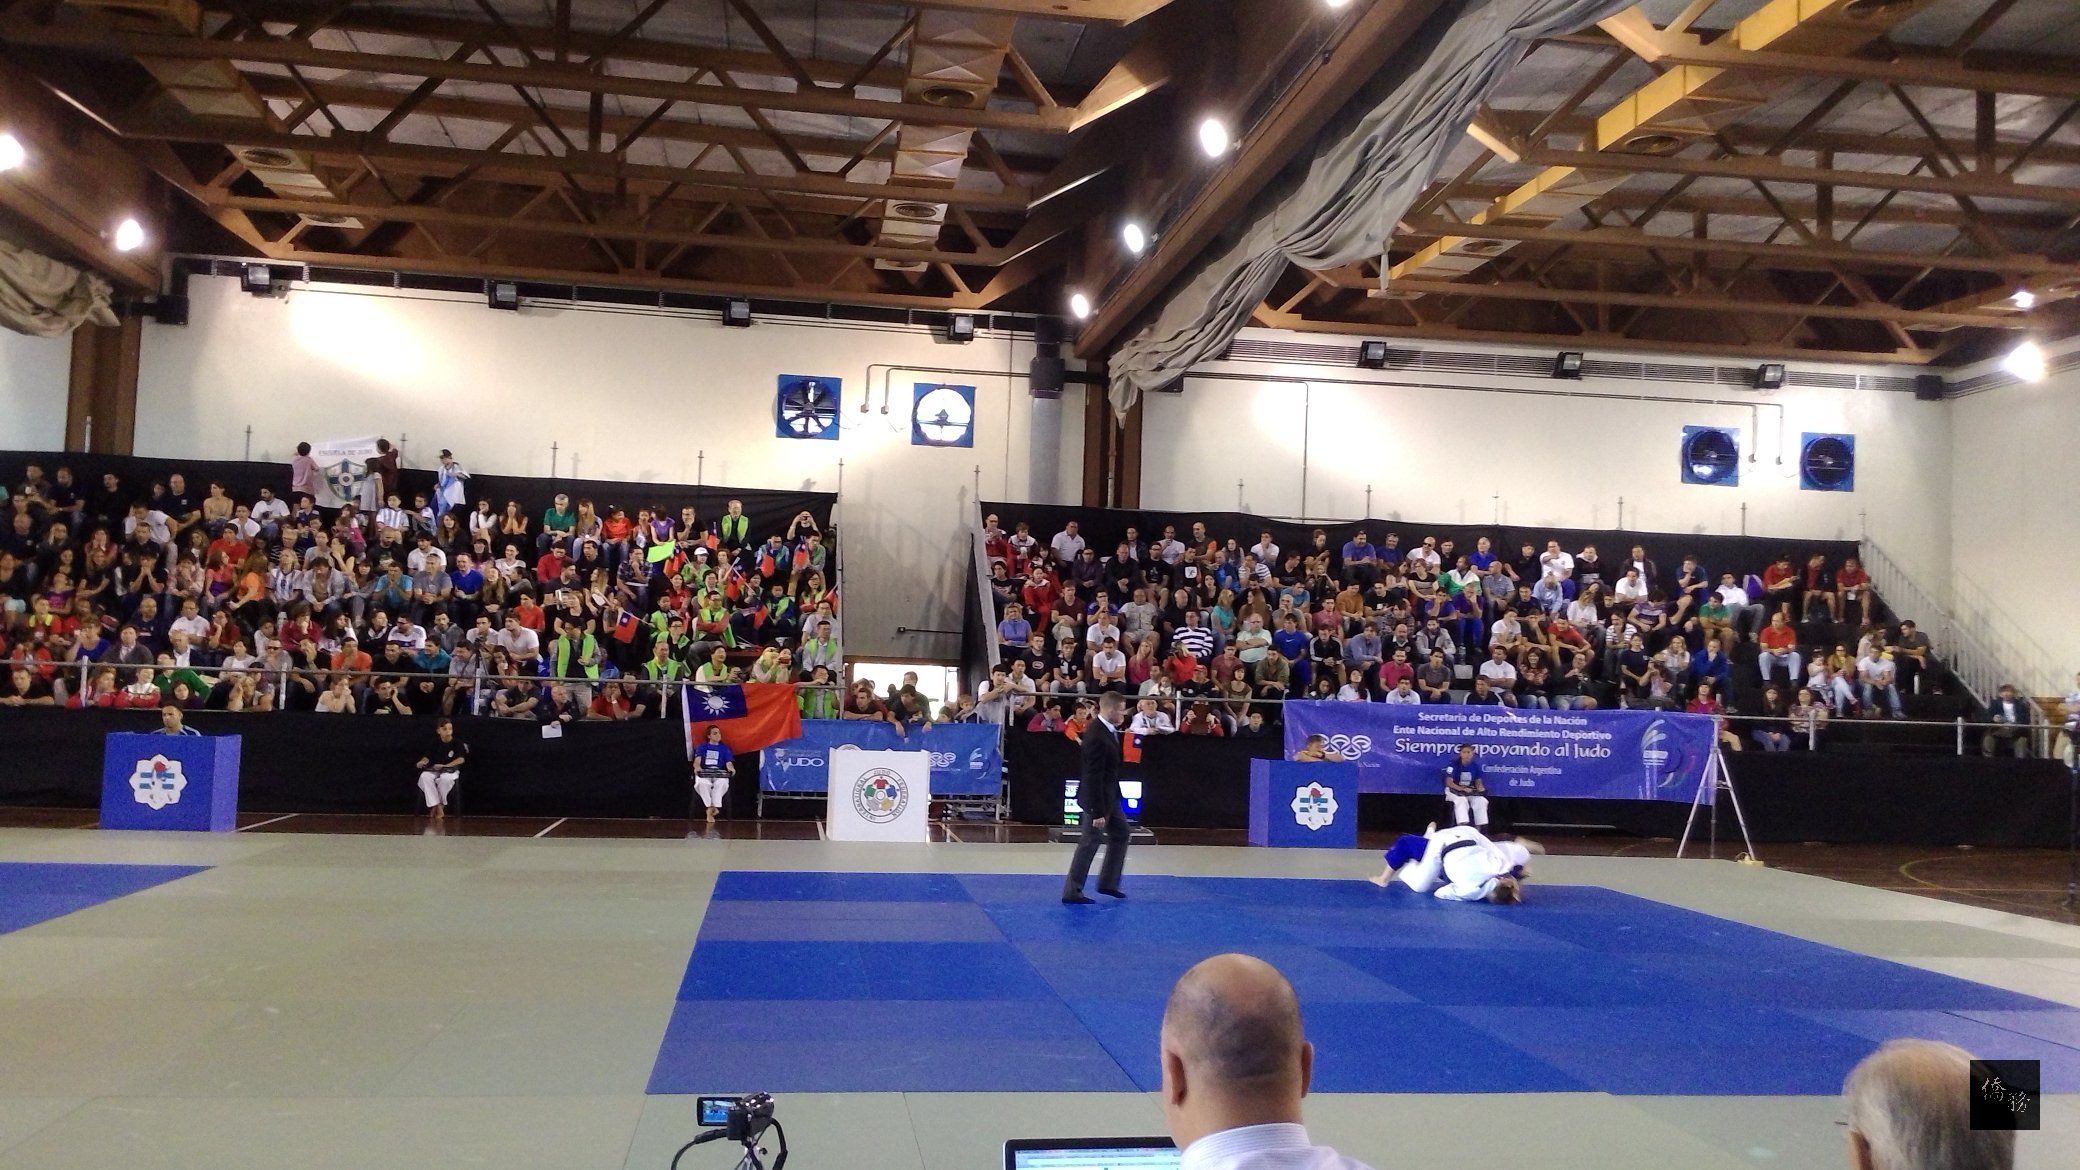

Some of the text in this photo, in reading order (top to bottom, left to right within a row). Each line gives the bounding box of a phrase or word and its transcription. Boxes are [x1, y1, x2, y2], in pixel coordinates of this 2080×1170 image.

[1469, 713, 1482, 723] de
[1483, 713, 1527, 725] Deportes
[1529, 715, 1542, 724] de
[1543, 715, 1552, 725] la
[1554, 716, 1588, 726] Nación
[1393, 725, 1612, 741] Ente Nacional de Alto Rendimiento Deportivo
[1395, 738, 1611, 759] Siempre apoyando al Judo
[1481, 764, 1562, 776] Confederación Argentina
[1509, 777, 1536, 787] de Judo
